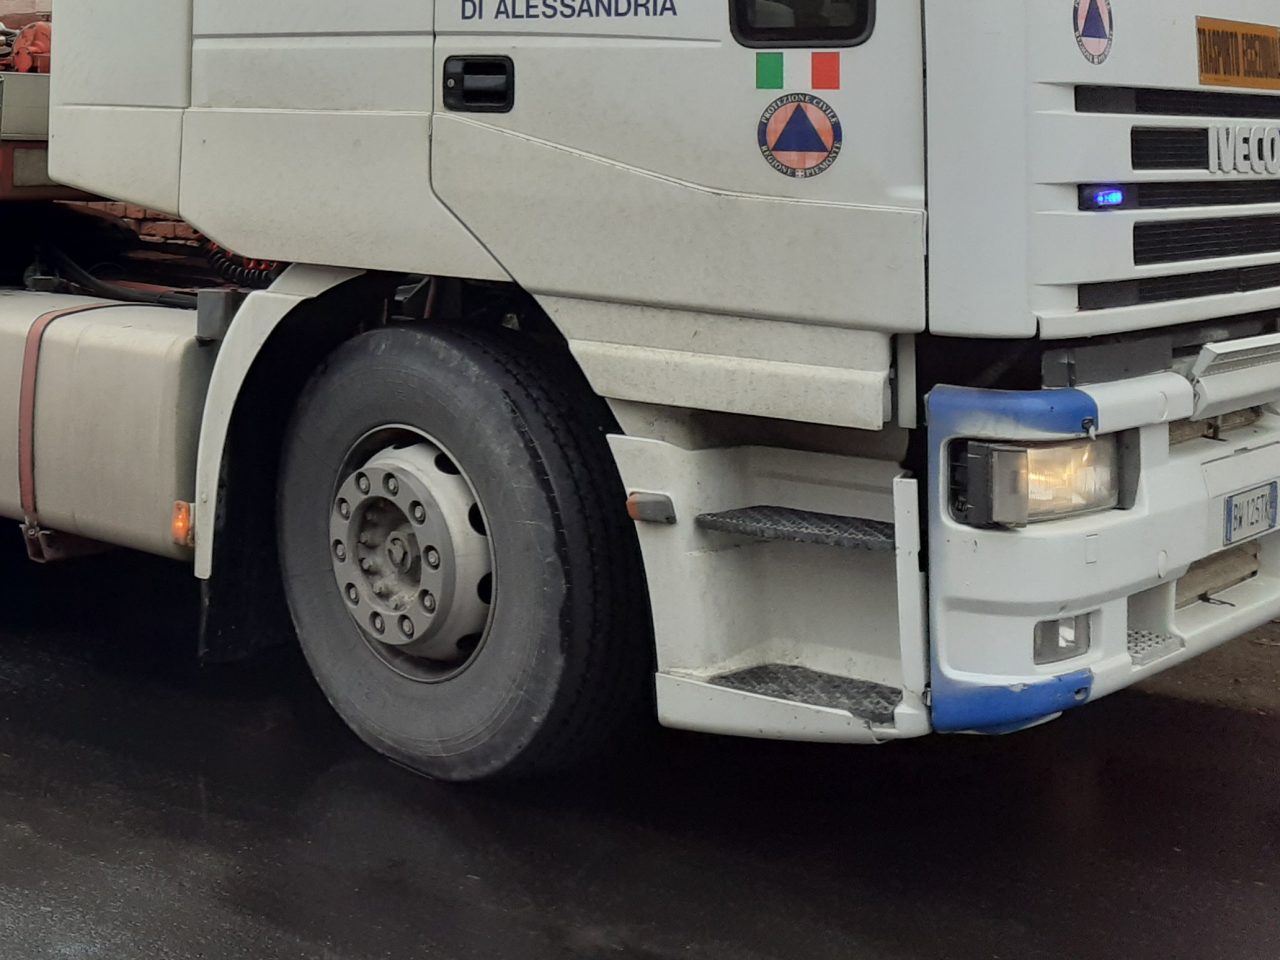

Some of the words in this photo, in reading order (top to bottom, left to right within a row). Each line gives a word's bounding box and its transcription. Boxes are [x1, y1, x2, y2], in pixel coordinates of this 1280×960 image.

[761, 94, 811, 124] PROTEZIONE
[813, 97, 839, 125] CIVILE
[761, 144, 793, 176] REGIONE
[805, 141, 841, 177] PIEMONTE
[1208, 126, 1280, 175] IVECO
